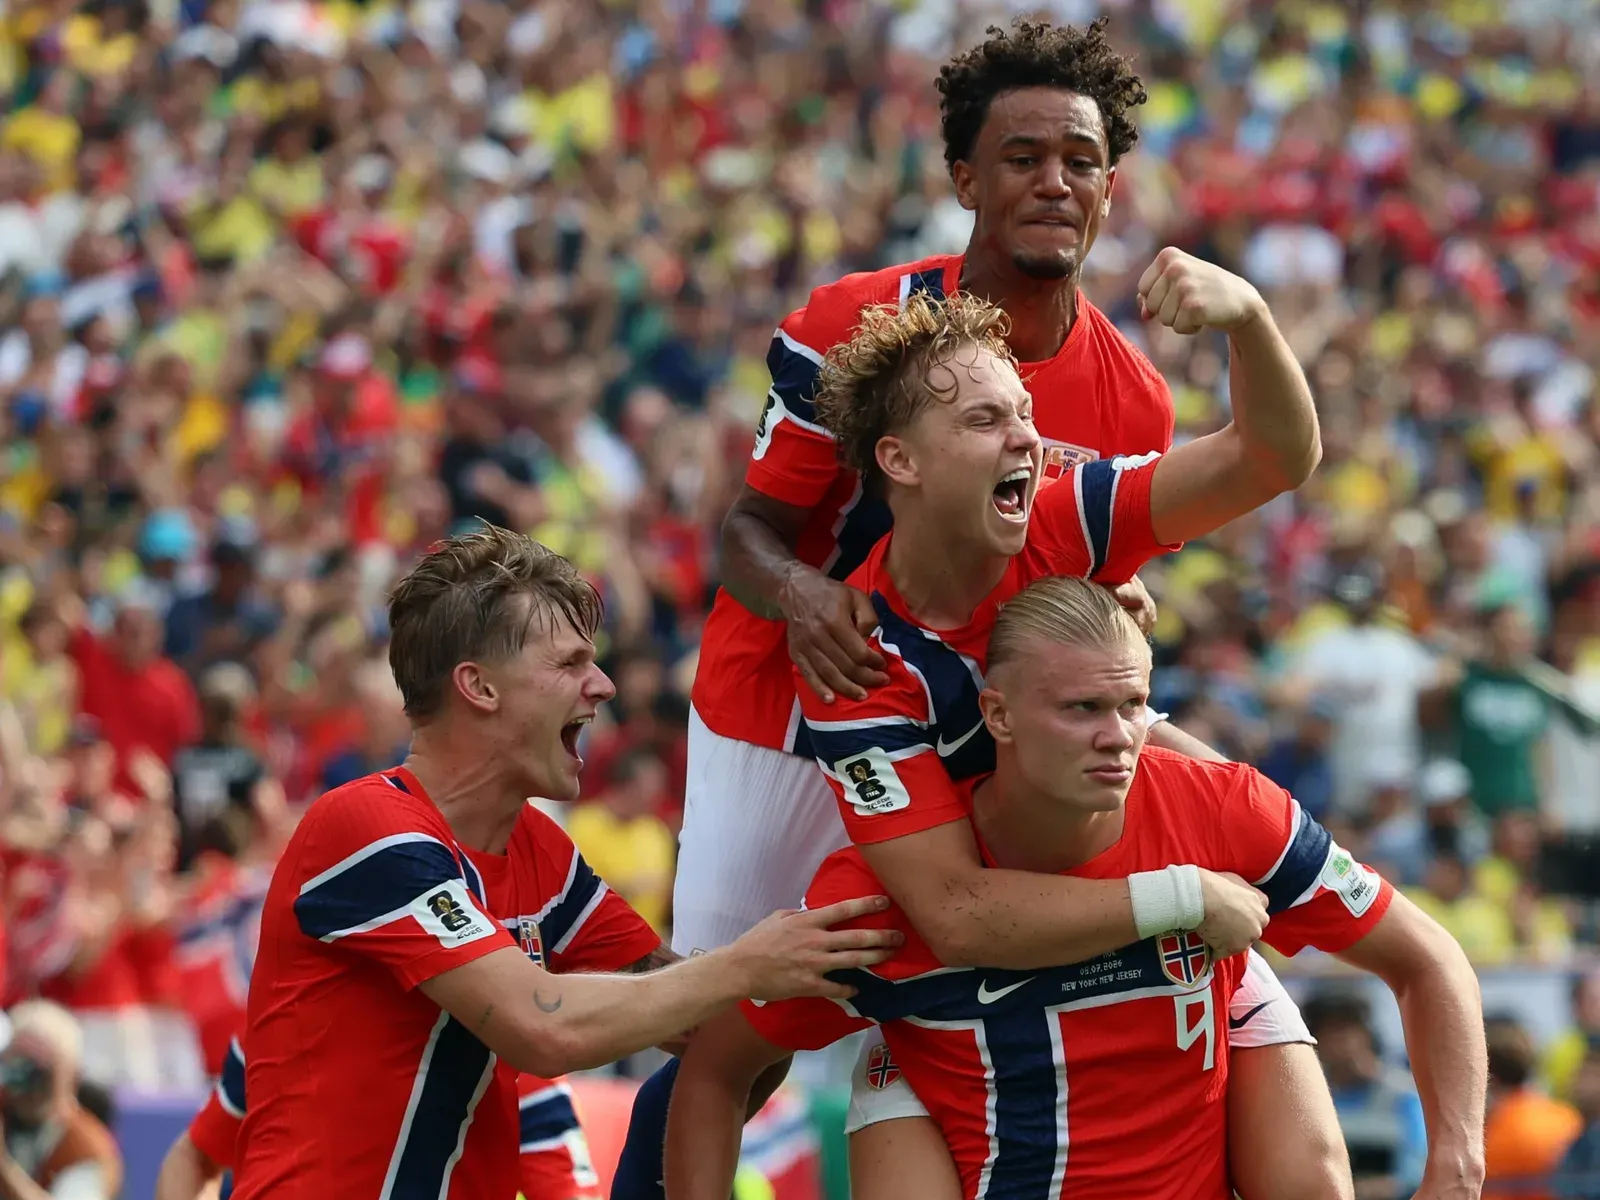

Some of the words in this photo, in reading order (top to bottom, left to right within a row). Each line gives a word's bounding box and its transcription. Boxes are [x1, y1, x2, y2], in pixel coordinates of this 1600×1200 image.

[1061, 981, 1077, 992] NEW
[1078, 978, 1098, 989] YORK
[1099, 973, 1114, 985] NEW
[1115, 968, 1142, 981] JERSEY
[1174, 985, 1215, 1070] 9
